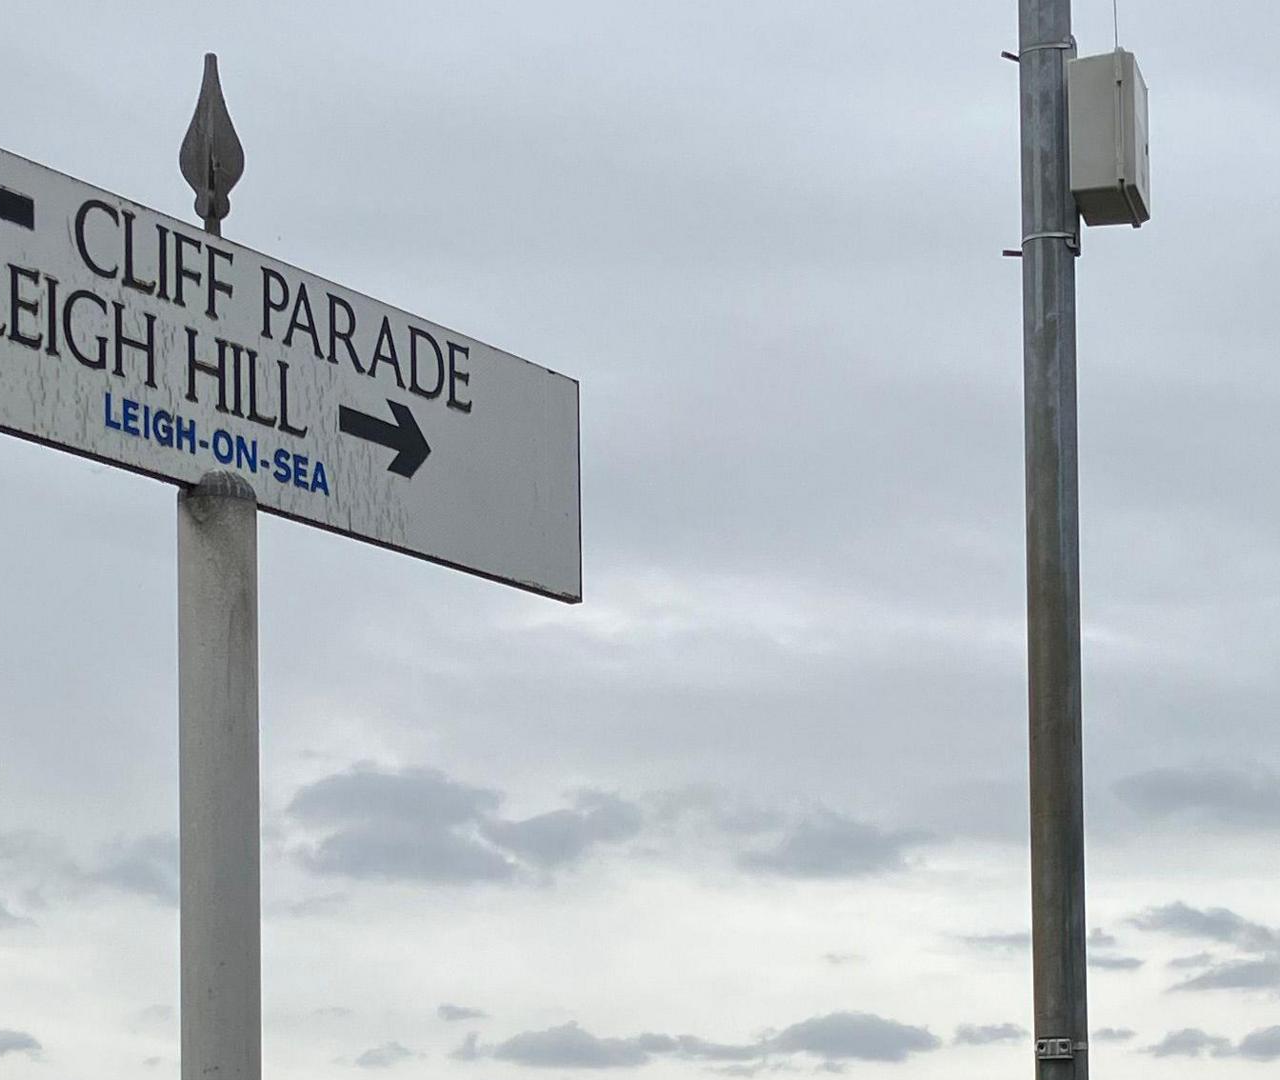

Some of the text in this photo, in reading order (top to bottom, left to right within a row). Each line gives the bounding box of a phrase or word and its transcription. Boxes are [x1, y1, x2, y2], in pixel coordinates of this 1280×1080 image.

[75, 199, 472, 414] CLIFF PARADE
[185, 326, 307, 439] HILL
[105, 392, 329, 496] LEIGH-ON-SEA
